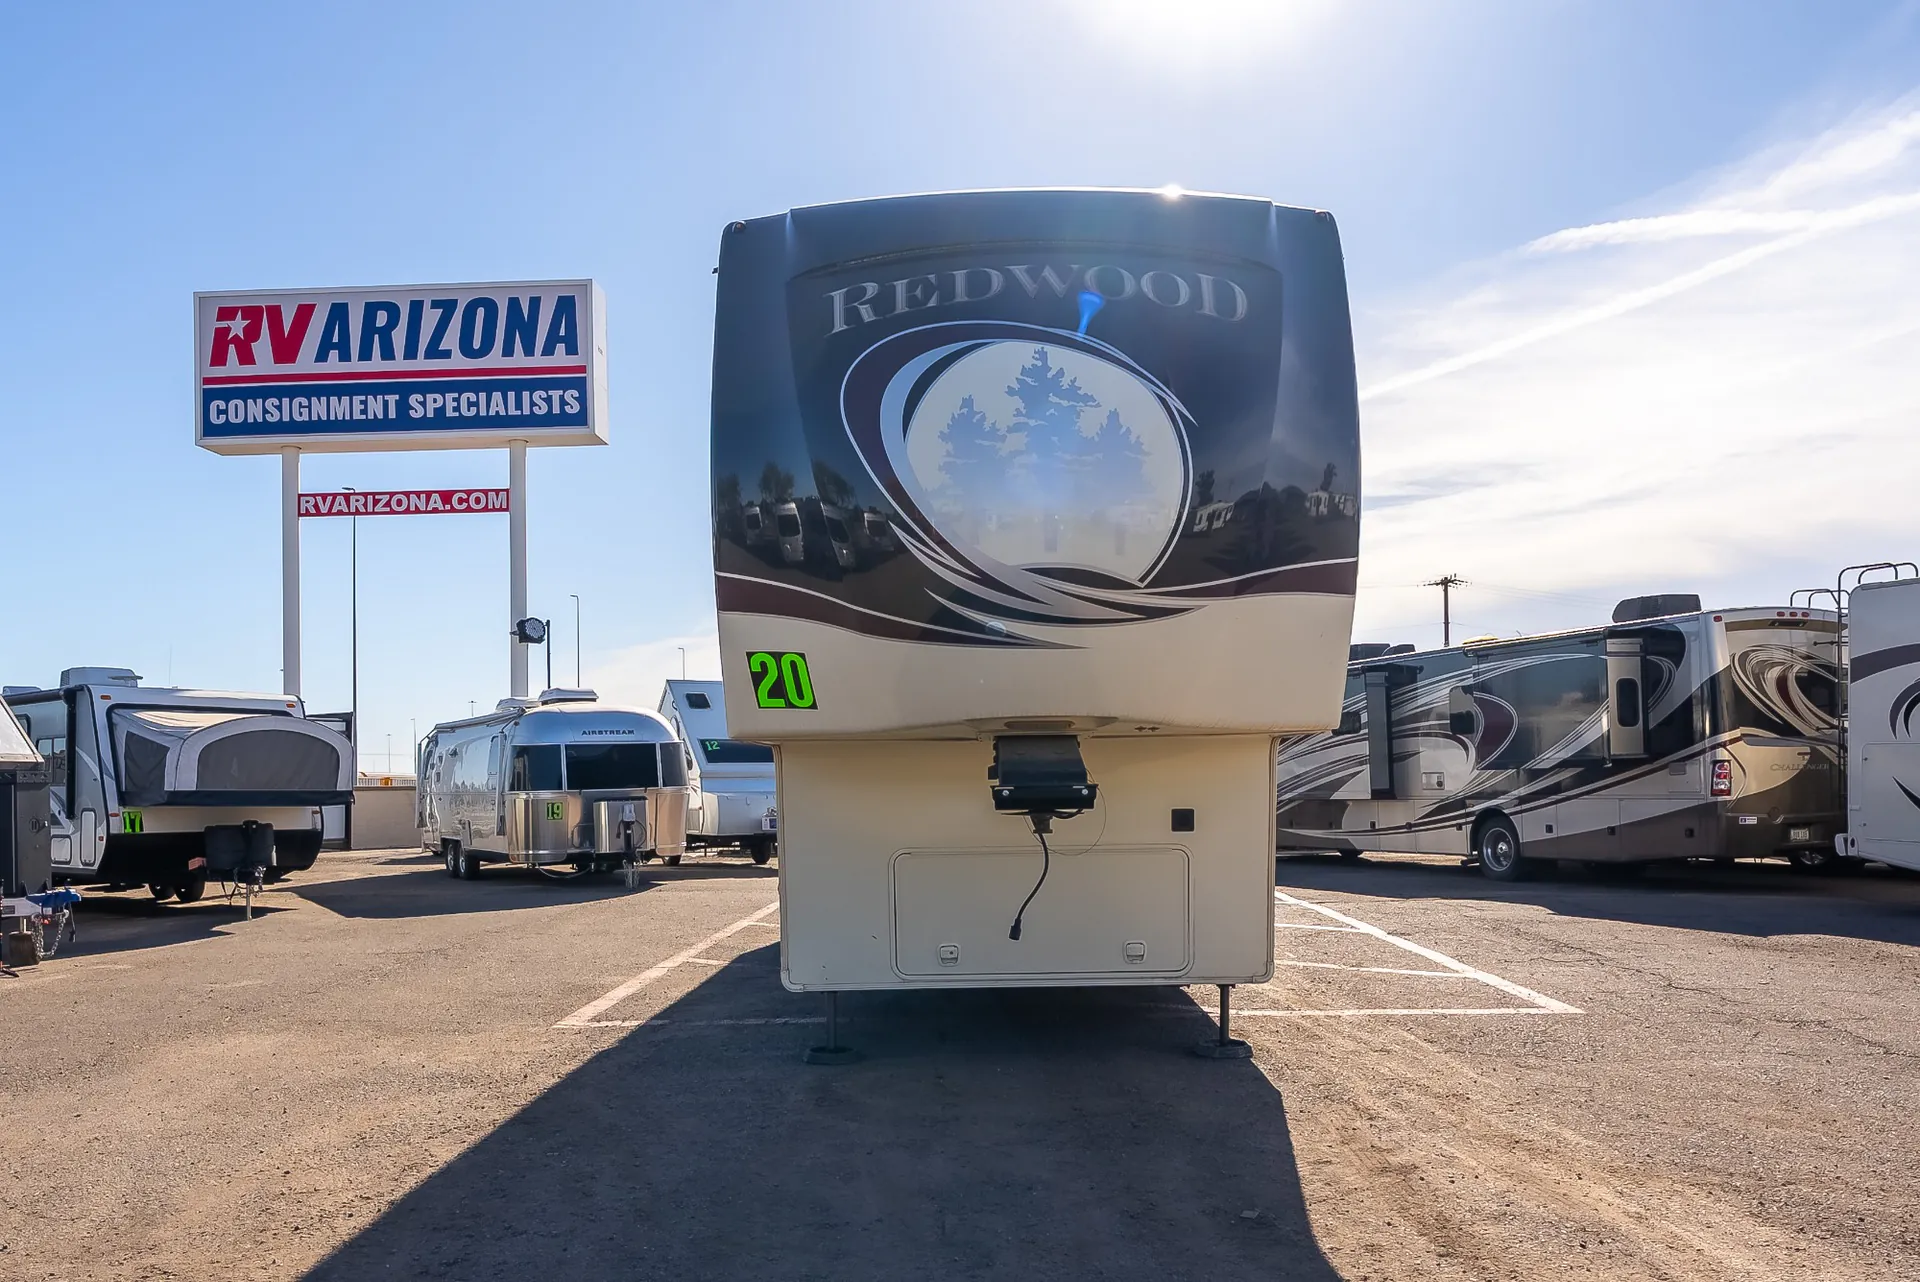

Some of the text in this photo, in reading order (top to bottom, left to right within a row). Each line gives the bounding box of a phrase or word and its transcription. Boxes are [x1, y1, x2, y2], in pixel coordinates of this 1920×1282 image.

[823, 264, 1249, 336] REDWOOD
[209, 389, 581, 424] CONSIGNMENT SPECIALISTS
[300, 491, 507, 514] RVARIZONA.COM
[750, 652, 813, 707] 20
[705, 740, 720, 750] 12
[124, 812, 141, 833] 17
[547, 803, 562, 820] 19
